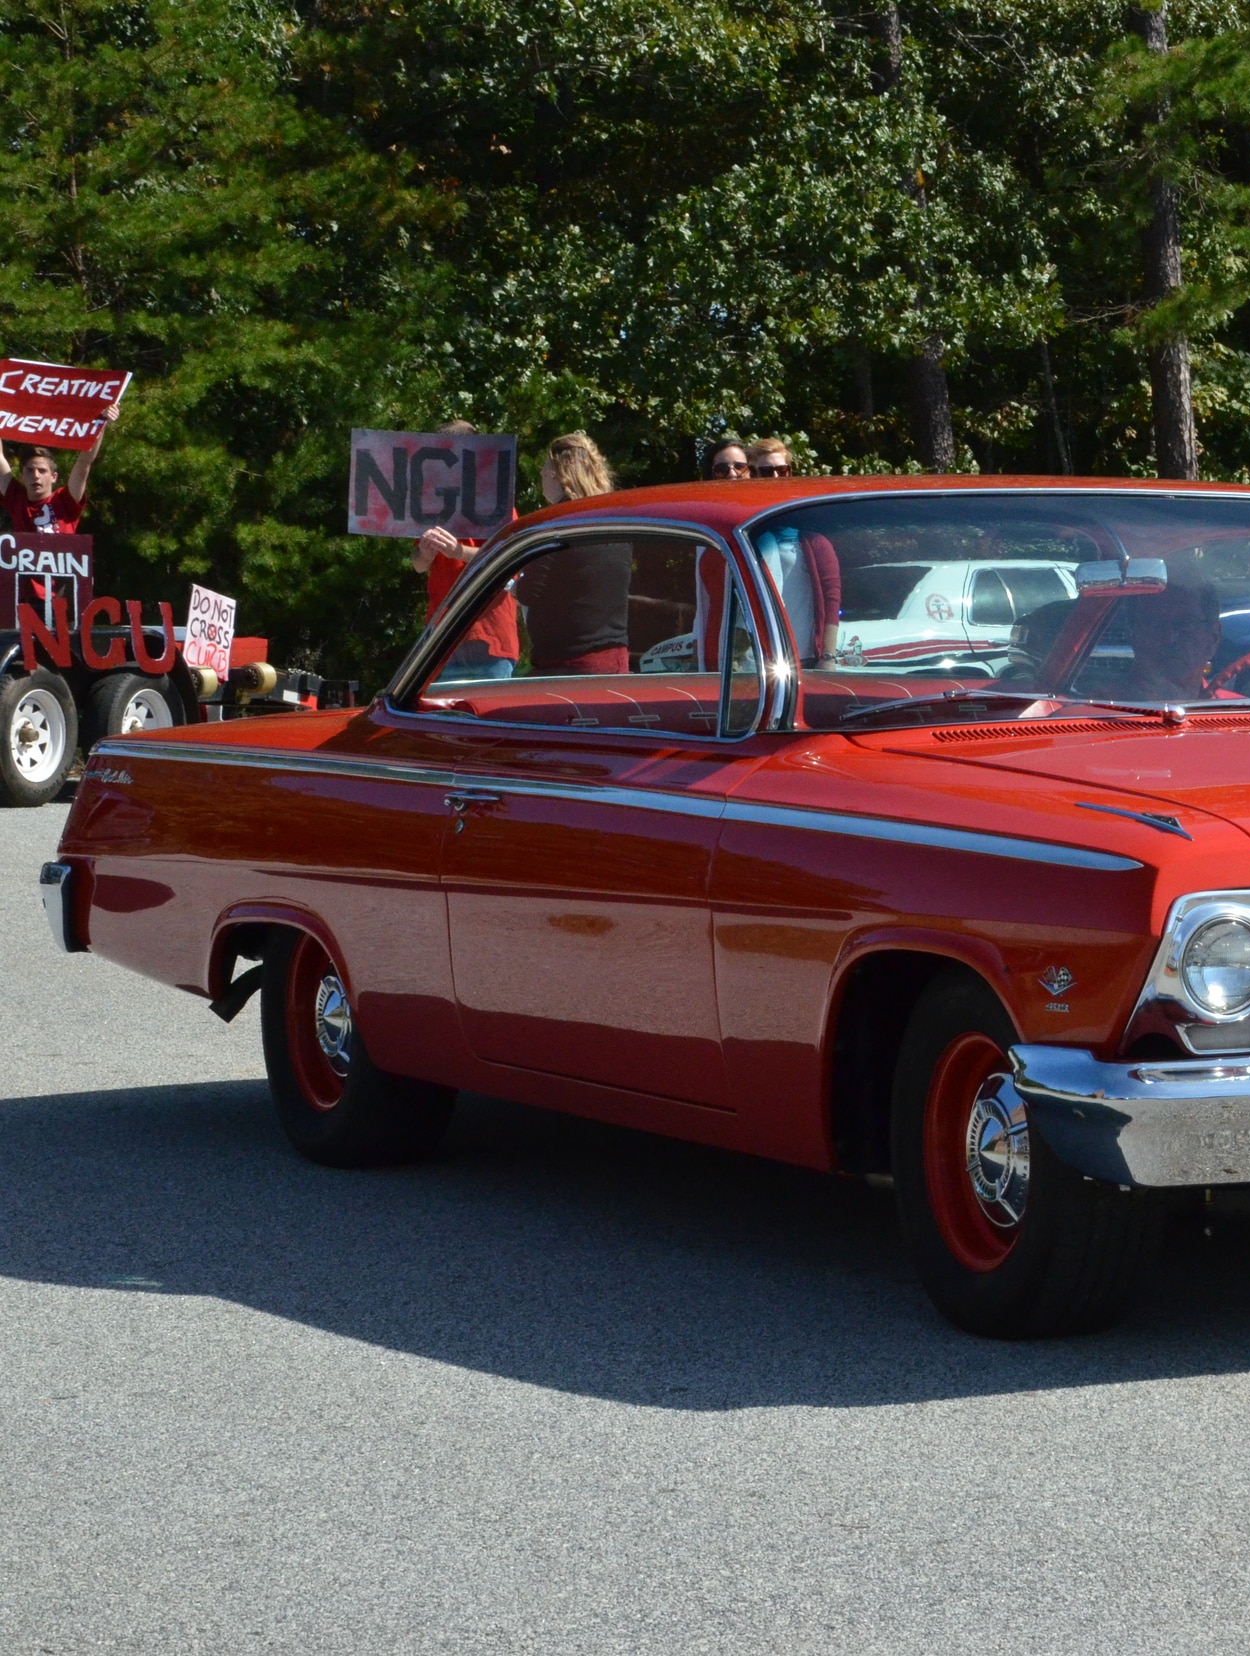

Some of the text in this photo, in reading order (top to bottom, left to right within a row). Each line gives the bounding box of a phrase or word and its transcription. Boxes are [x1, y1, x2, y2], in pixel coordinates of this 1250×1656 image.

[0, 369, 120, 401] CREATIVE
[355, 446, 511, 527] NGU
[0, 534, 89, 577] CRAIN
[192, 590, 235, 630] DO NOT
[190, 618, 230, 650] CROSS
[651, 641, 684, 656] CAMPUS
